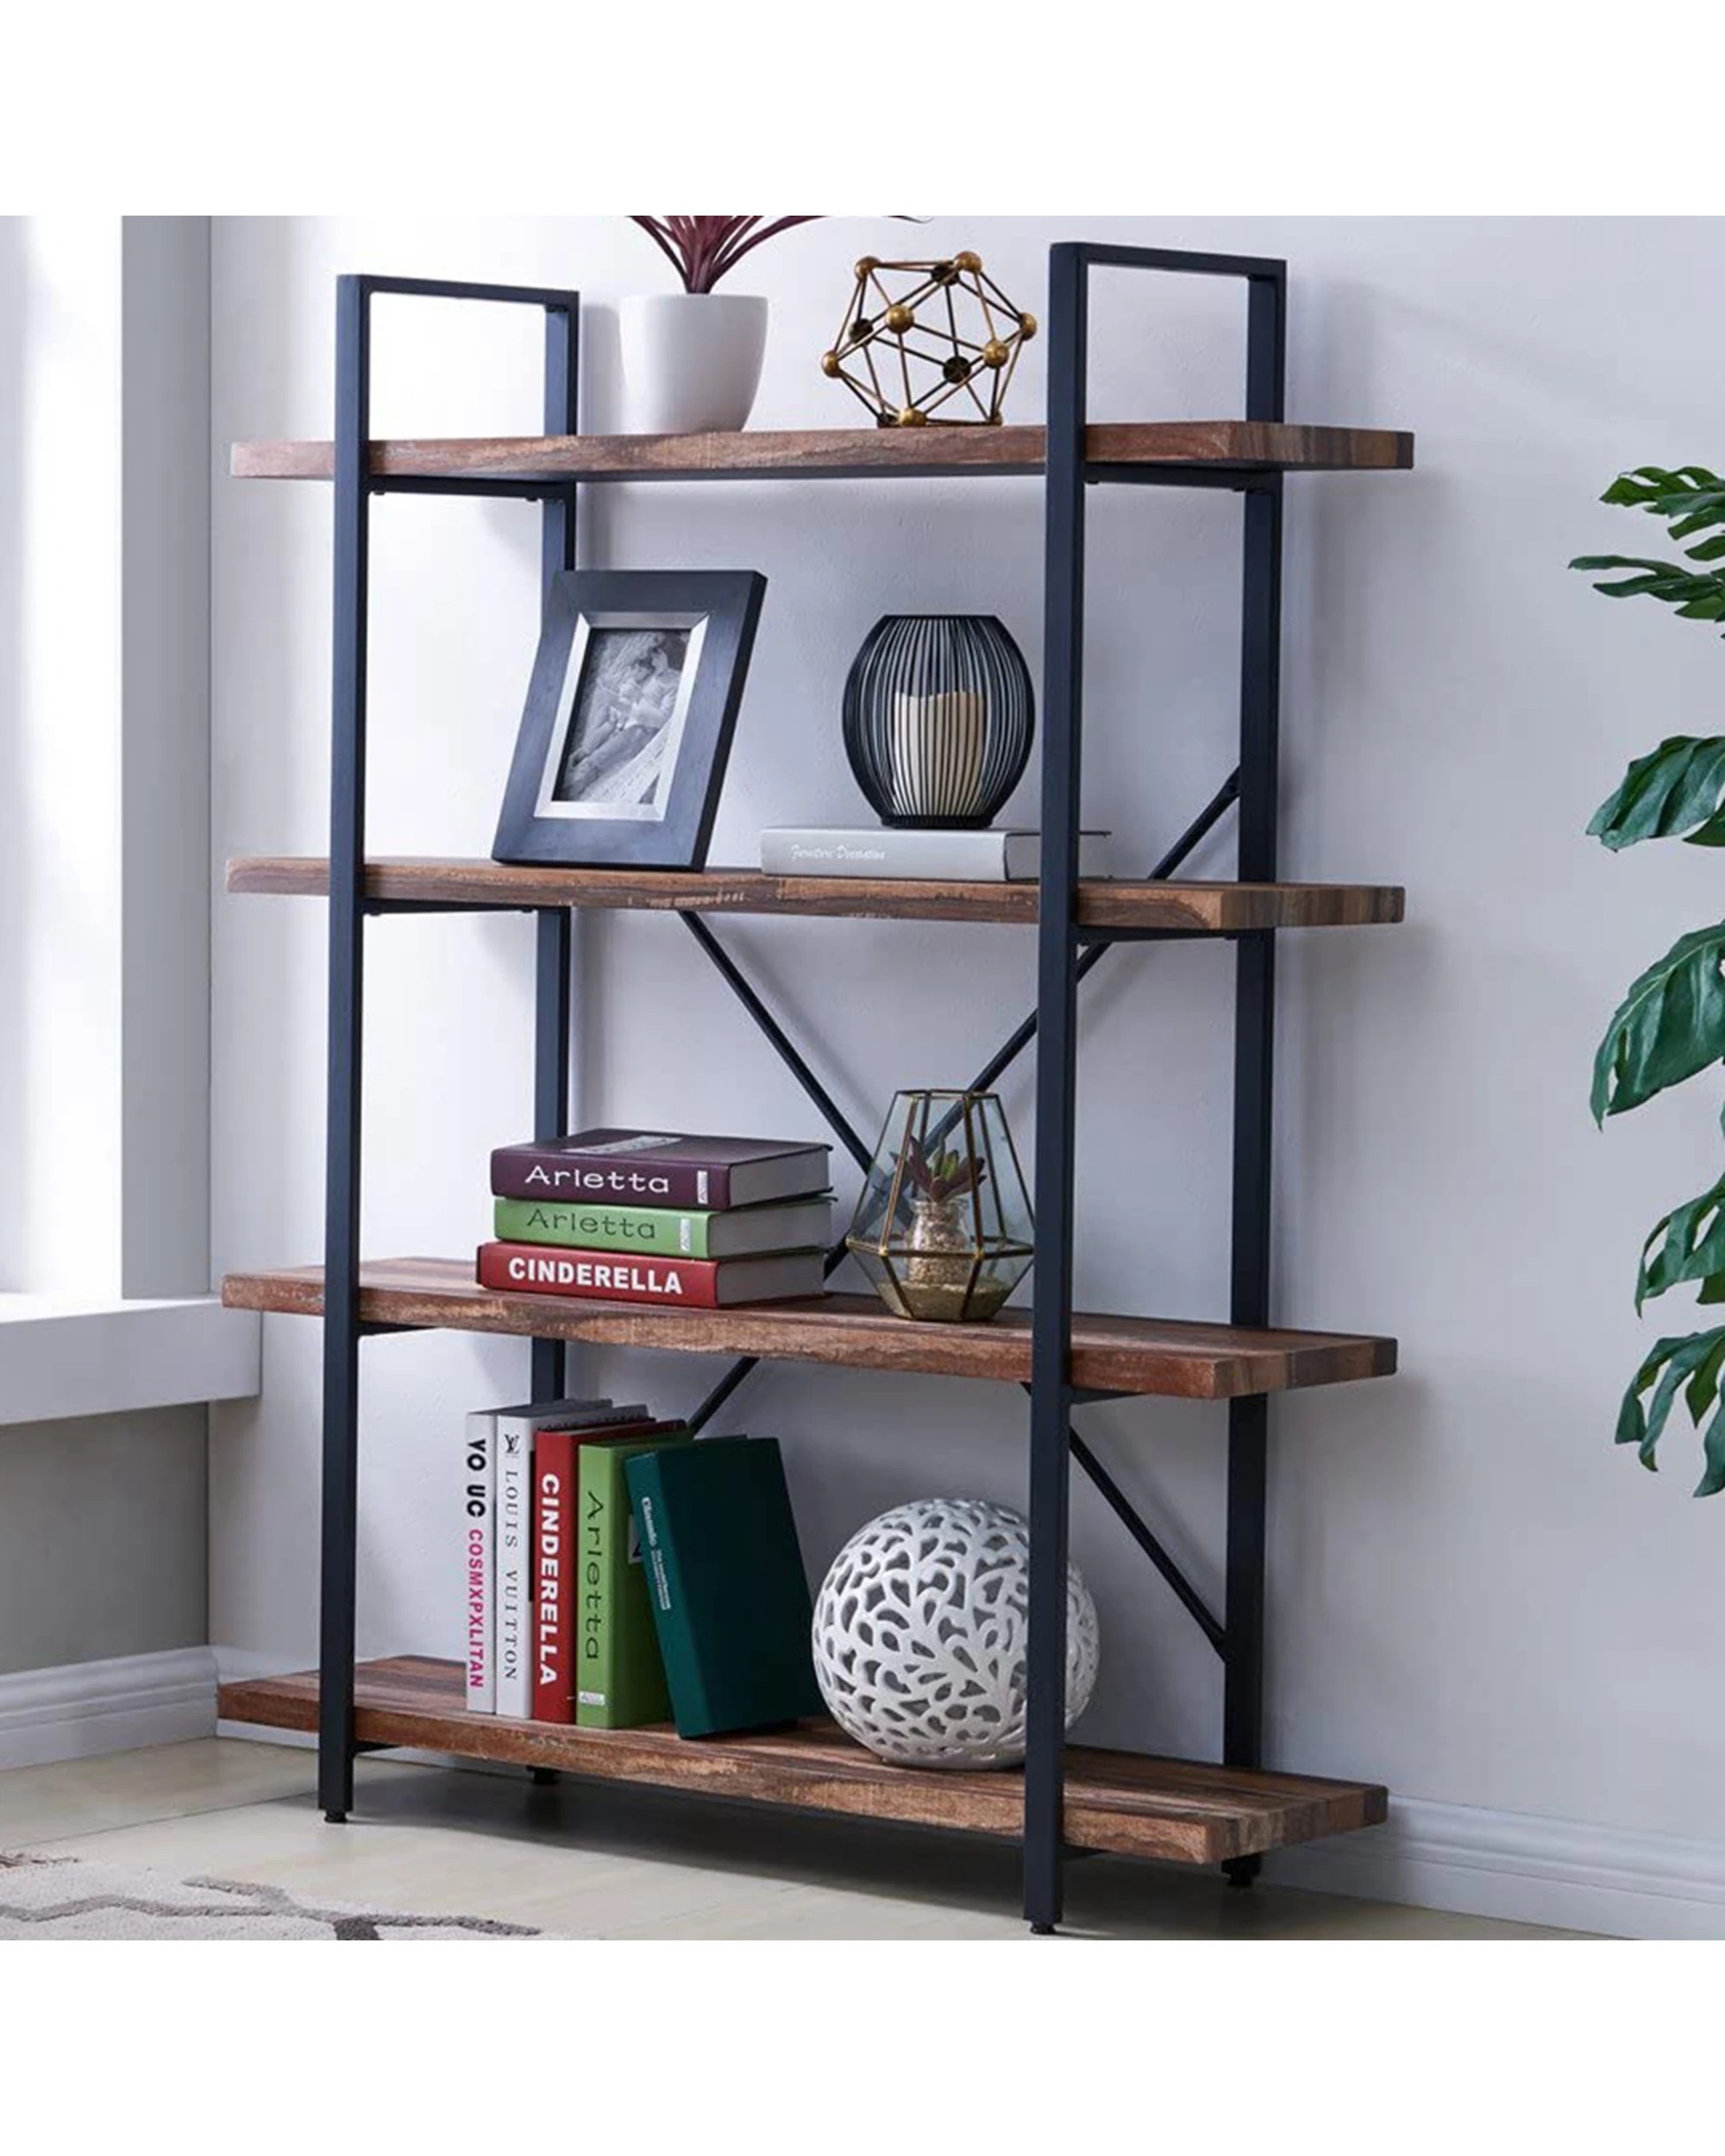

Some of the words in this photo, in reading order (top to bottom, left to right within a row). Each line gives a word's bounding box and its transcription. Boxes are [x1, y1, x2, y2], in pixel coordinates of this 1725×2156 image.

[524, 1165, 669, 1194] Arletta
[527, 1208, 656, 1239] Arletta
[508, 1257, 682, 1294] CINDERELLA
[505, 1470, 518, 1549] LOUIS
[468, 1529, 484, 1688] COSMXPXLITAN
[541, 1473, 559, 1685] CINDERELLA
[586, 1491, 603, 1659] Arletta
[505, 1570, 518, 1680] VUITTON
